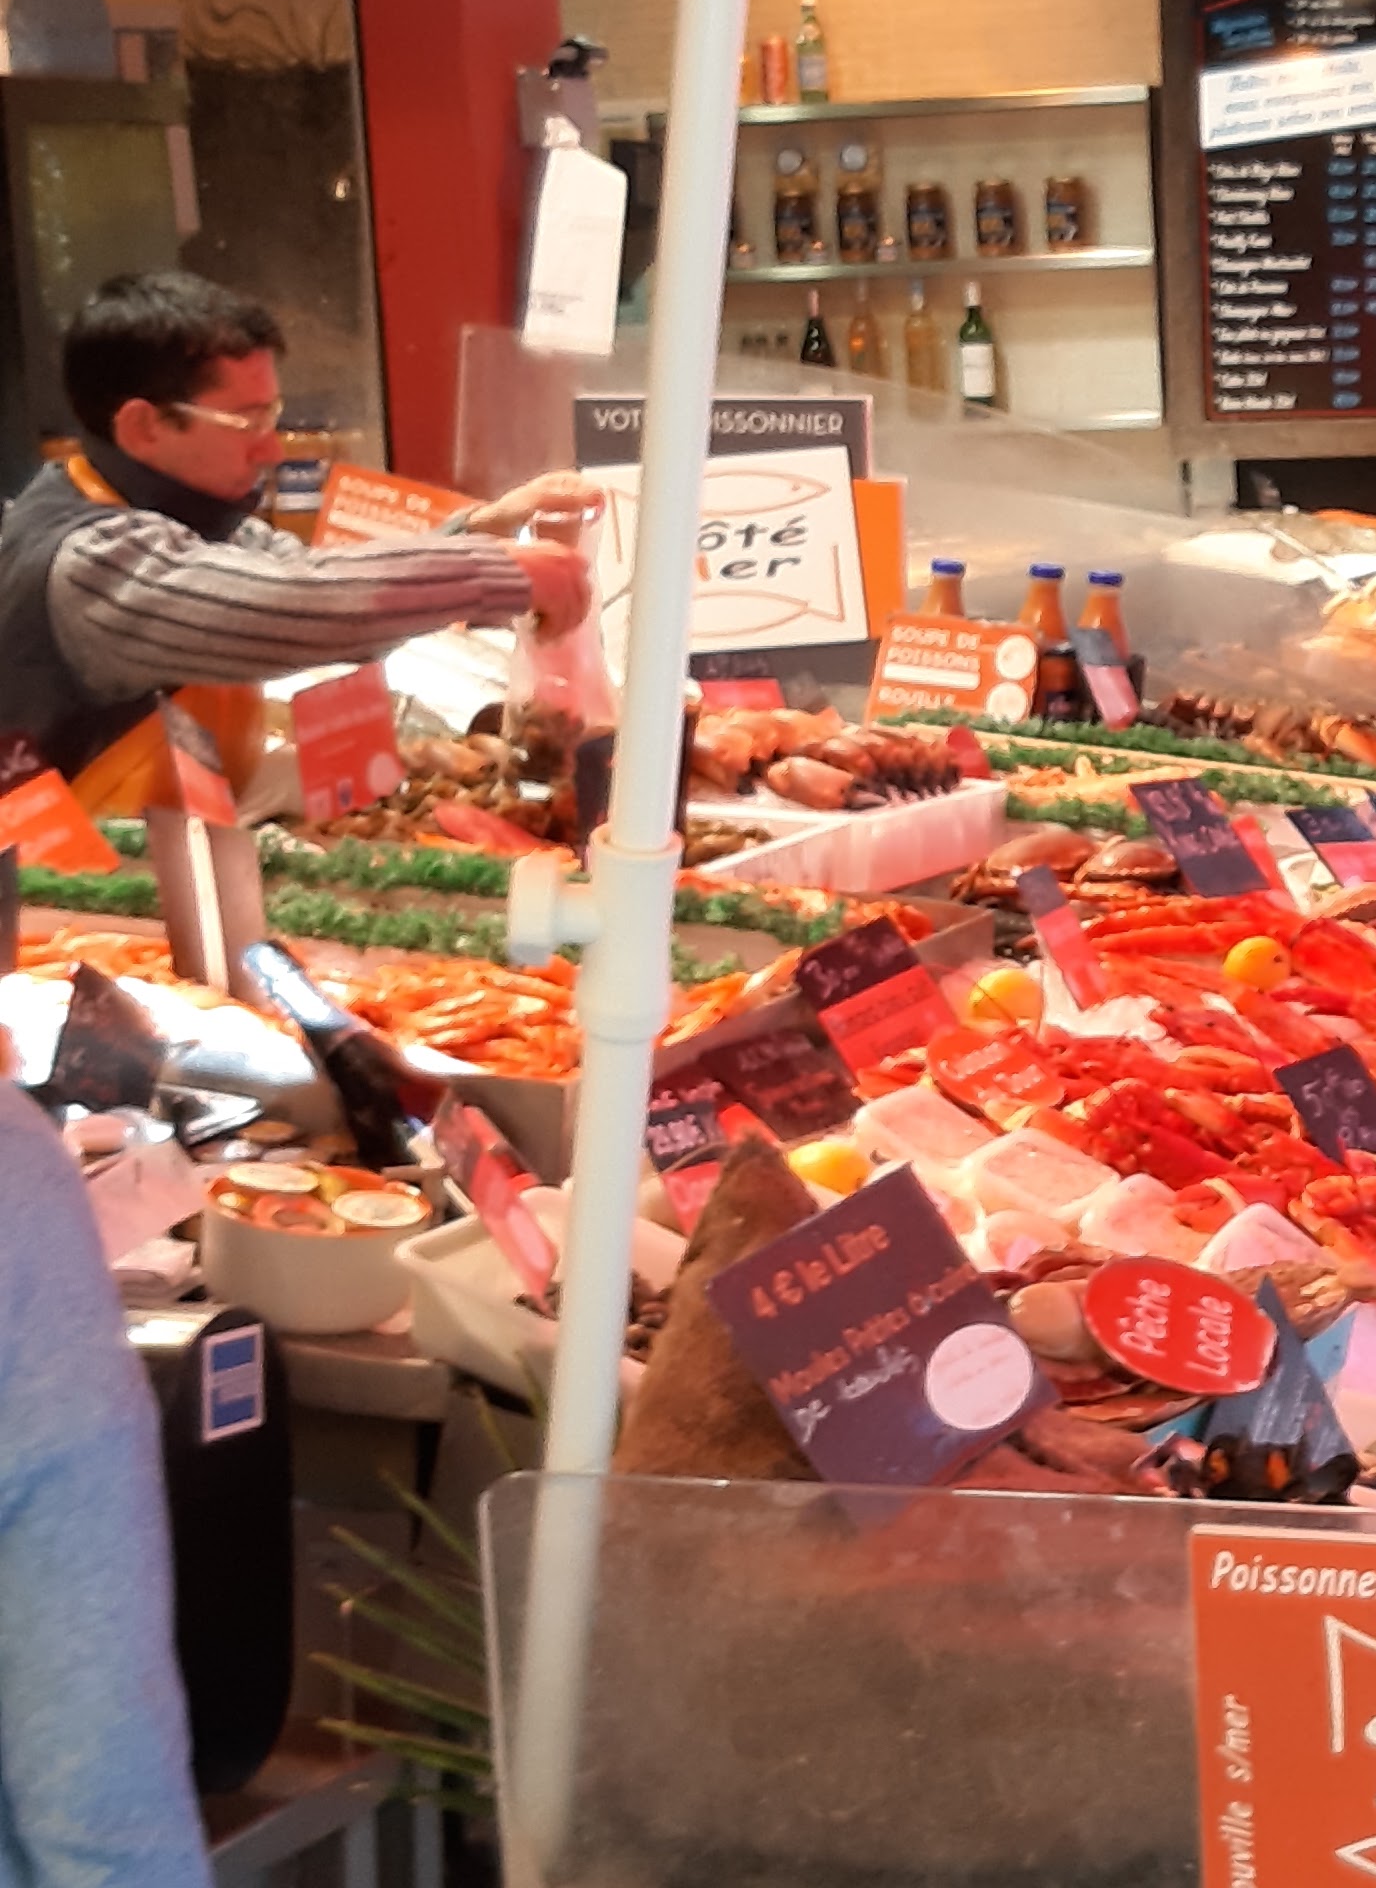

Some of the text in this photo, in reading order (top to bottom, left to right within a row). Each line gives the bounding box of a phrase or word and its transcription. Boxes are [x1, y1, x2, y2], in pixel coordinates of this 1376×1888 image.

[592, 408, 844, 435] VOT ISSONNIER
[697, 514, 807, 551] ôté
[695, 553, 803, 580] er
[1116, 1278, 1172, 1357] Pêche
[1184, 1295, 1233, 1377] Locale
[1215, 1693, 1253, 1784] s/mer
